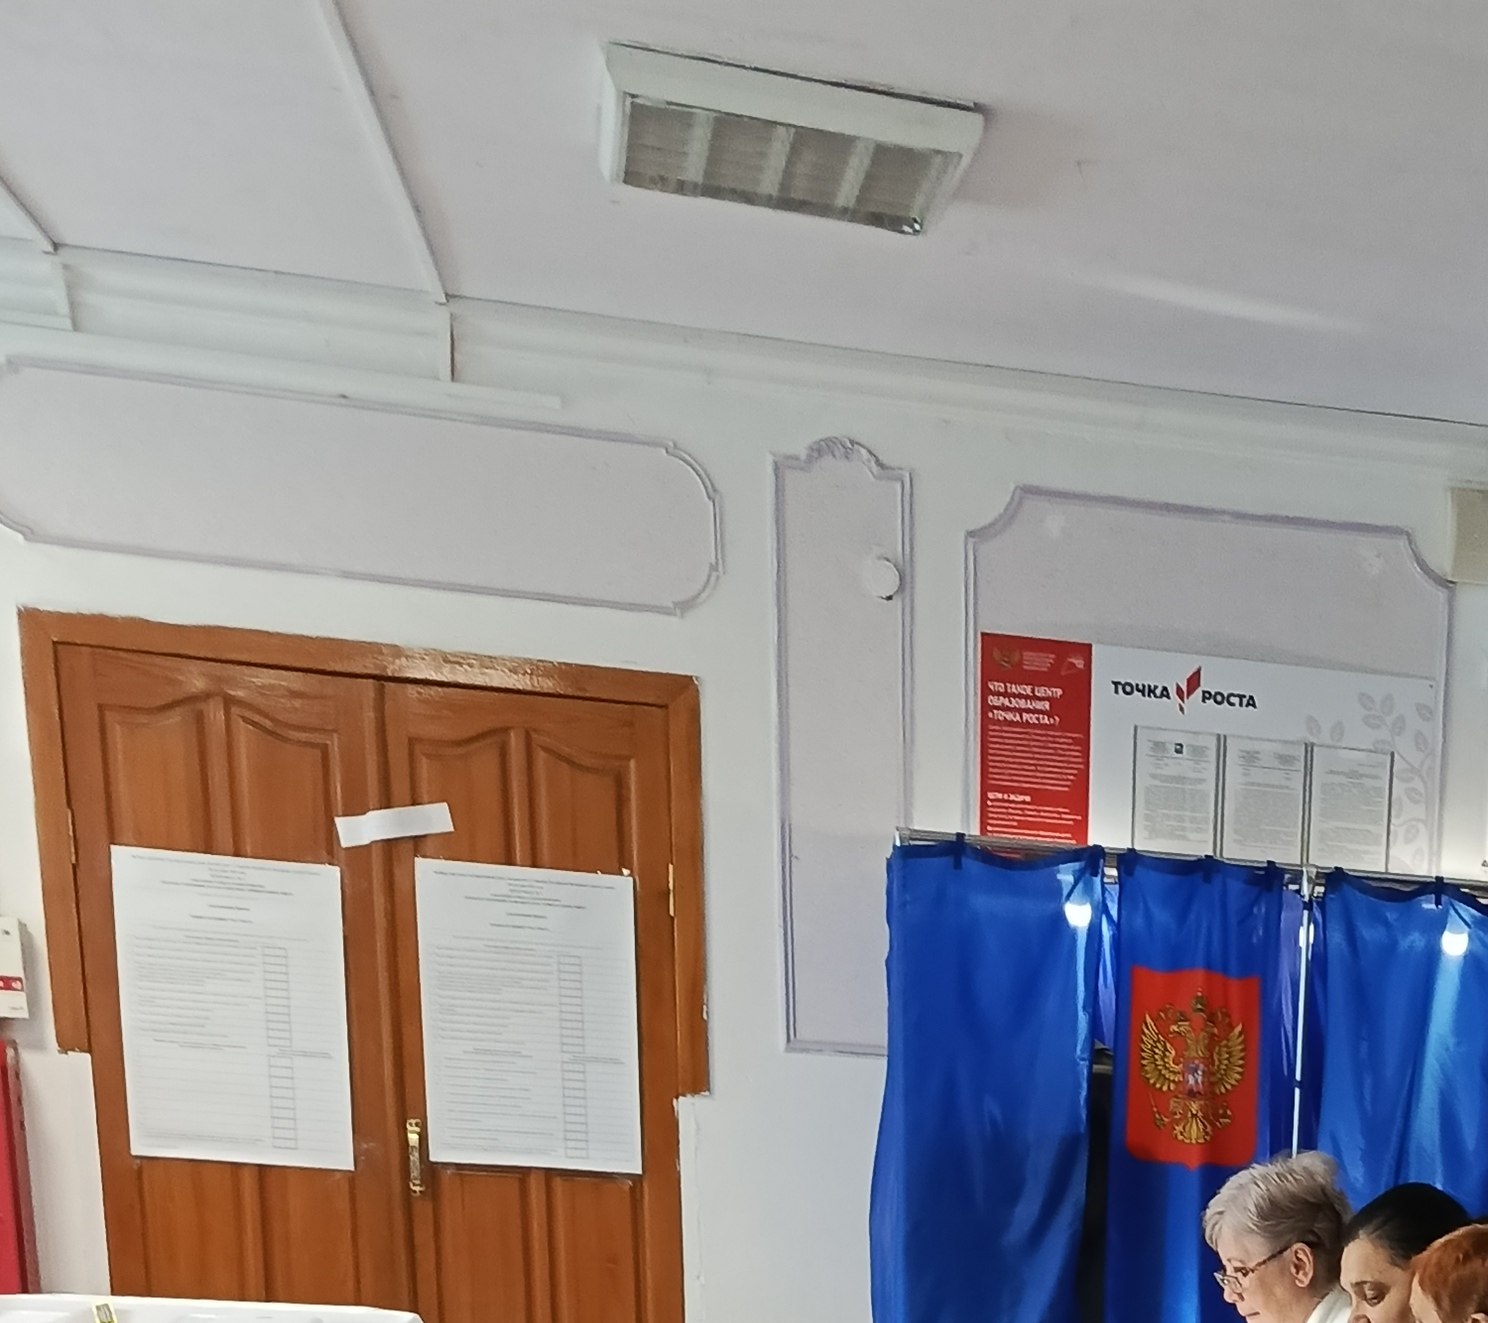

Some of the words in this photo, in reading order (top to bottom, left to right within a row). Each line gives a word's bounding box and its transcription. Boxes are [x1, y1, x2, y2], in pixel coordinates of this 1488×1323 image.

[987, 681, 1005, 693] ЧТО
[1034, 686, 1063, 699] ЦЕНТР
[1111, 680, 1172, 700] ТОЧКА
[1201, 689, 1258, 709] РОСТА
